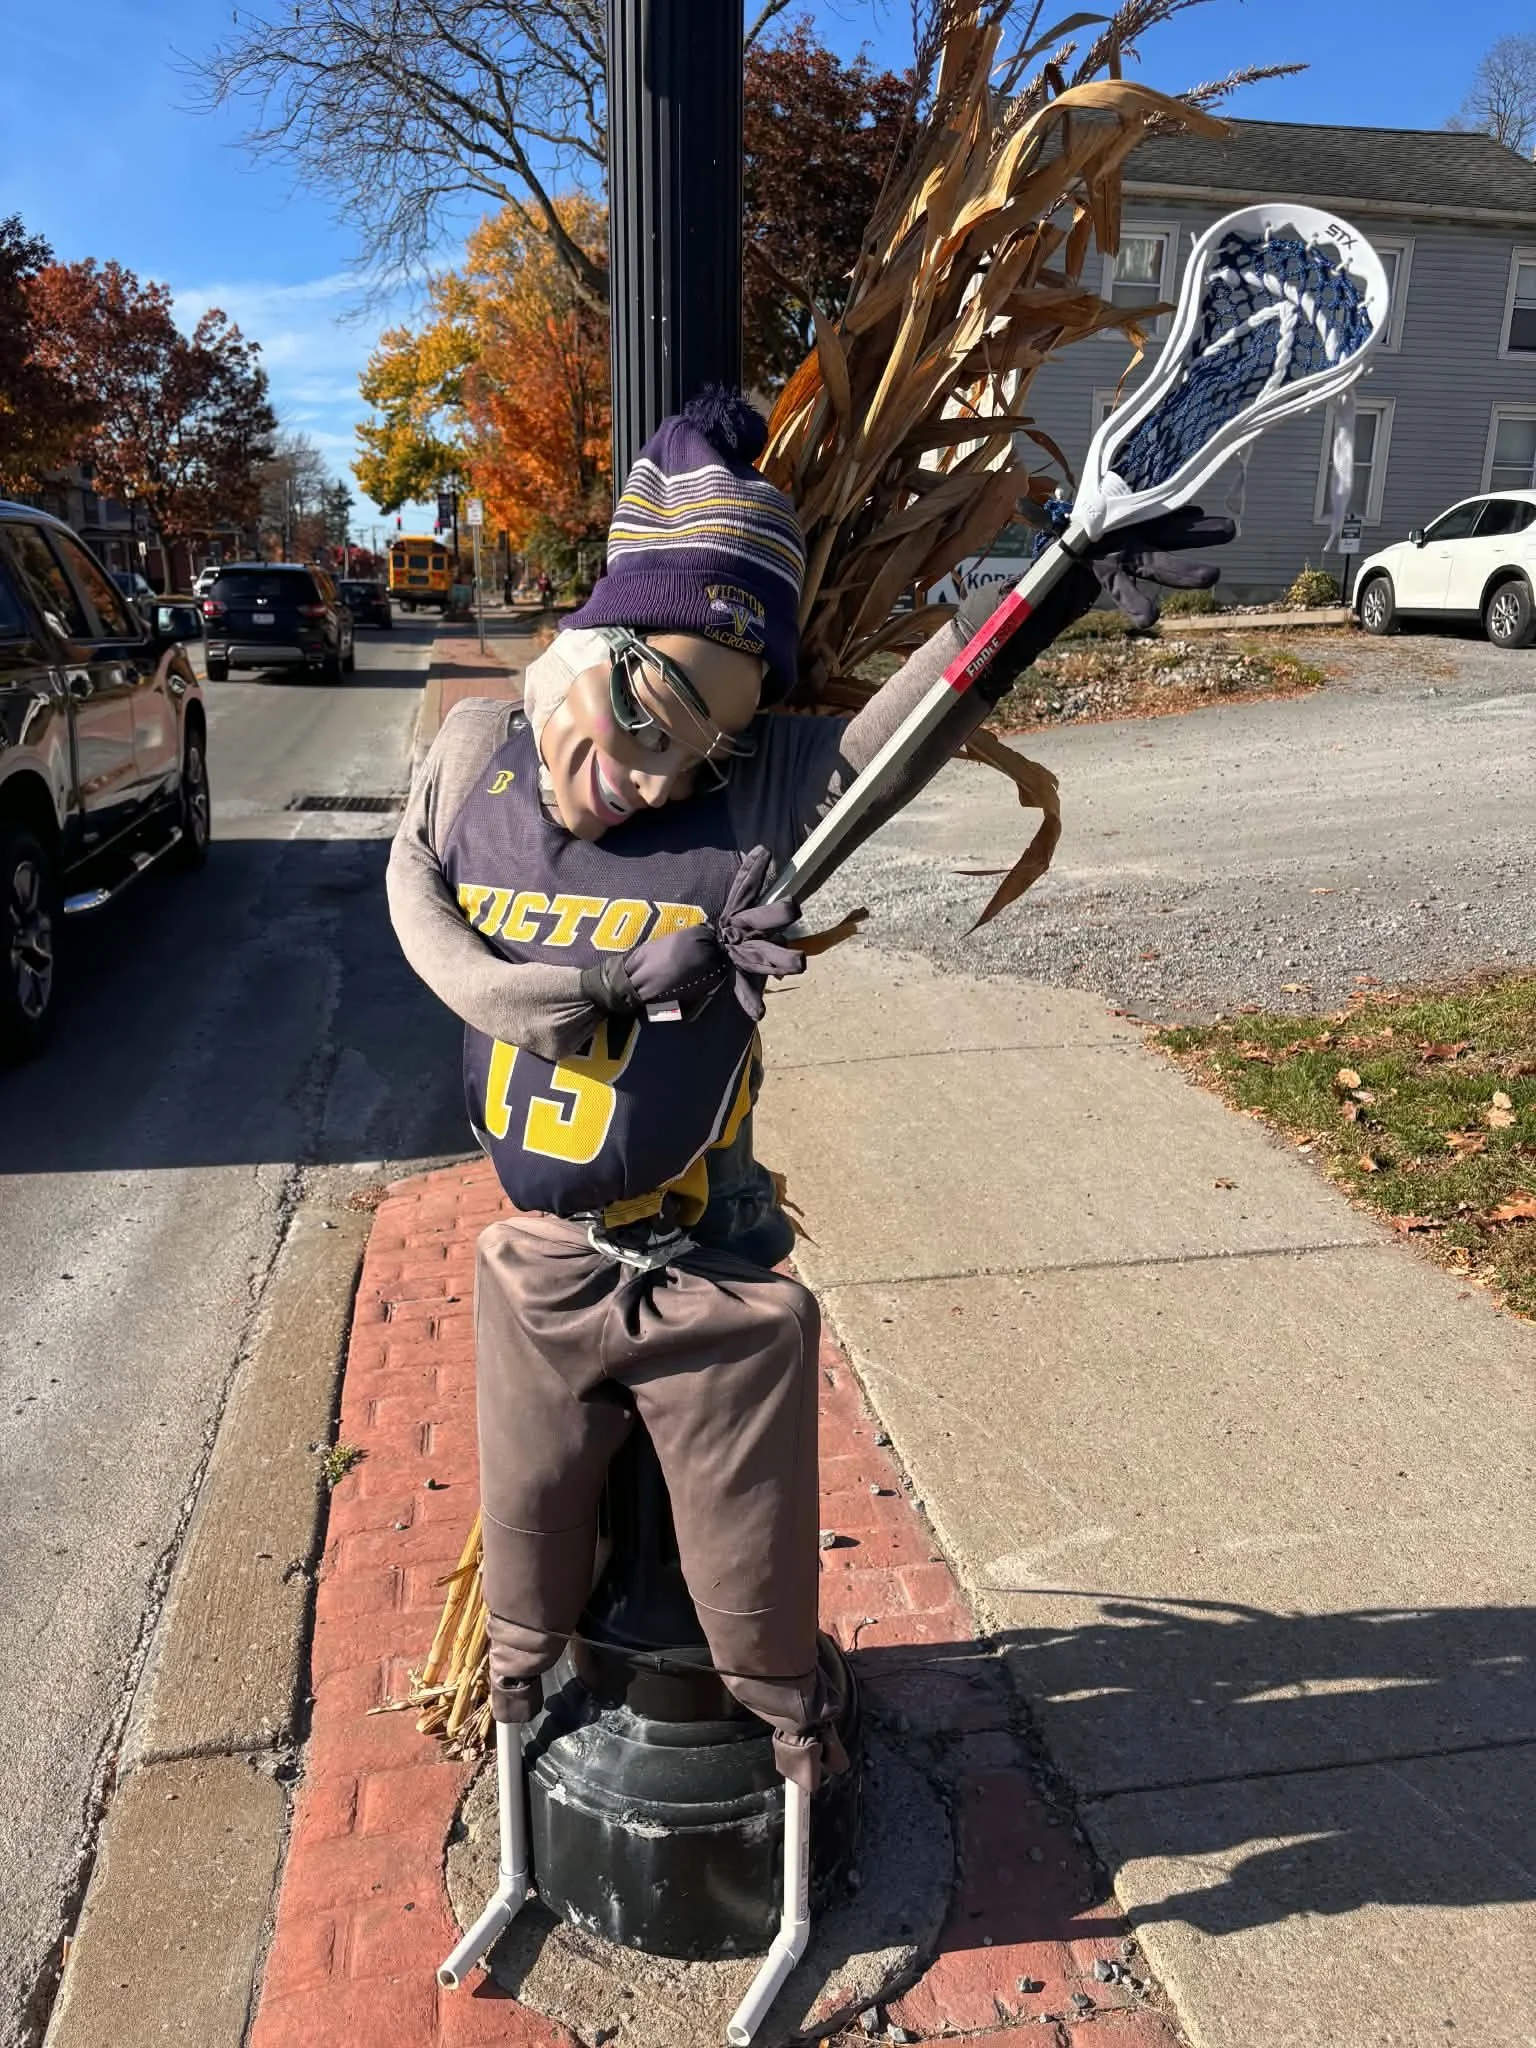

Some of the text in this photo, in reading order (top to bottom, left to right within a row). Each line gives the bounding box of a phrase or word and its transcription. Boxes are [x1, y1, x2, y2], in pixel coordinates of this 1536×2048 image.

[1324, 223, 1358, 250] STX
[704, 584, 765, 618] VICTOR
[703, 624, 766, 655] LACROSSE
